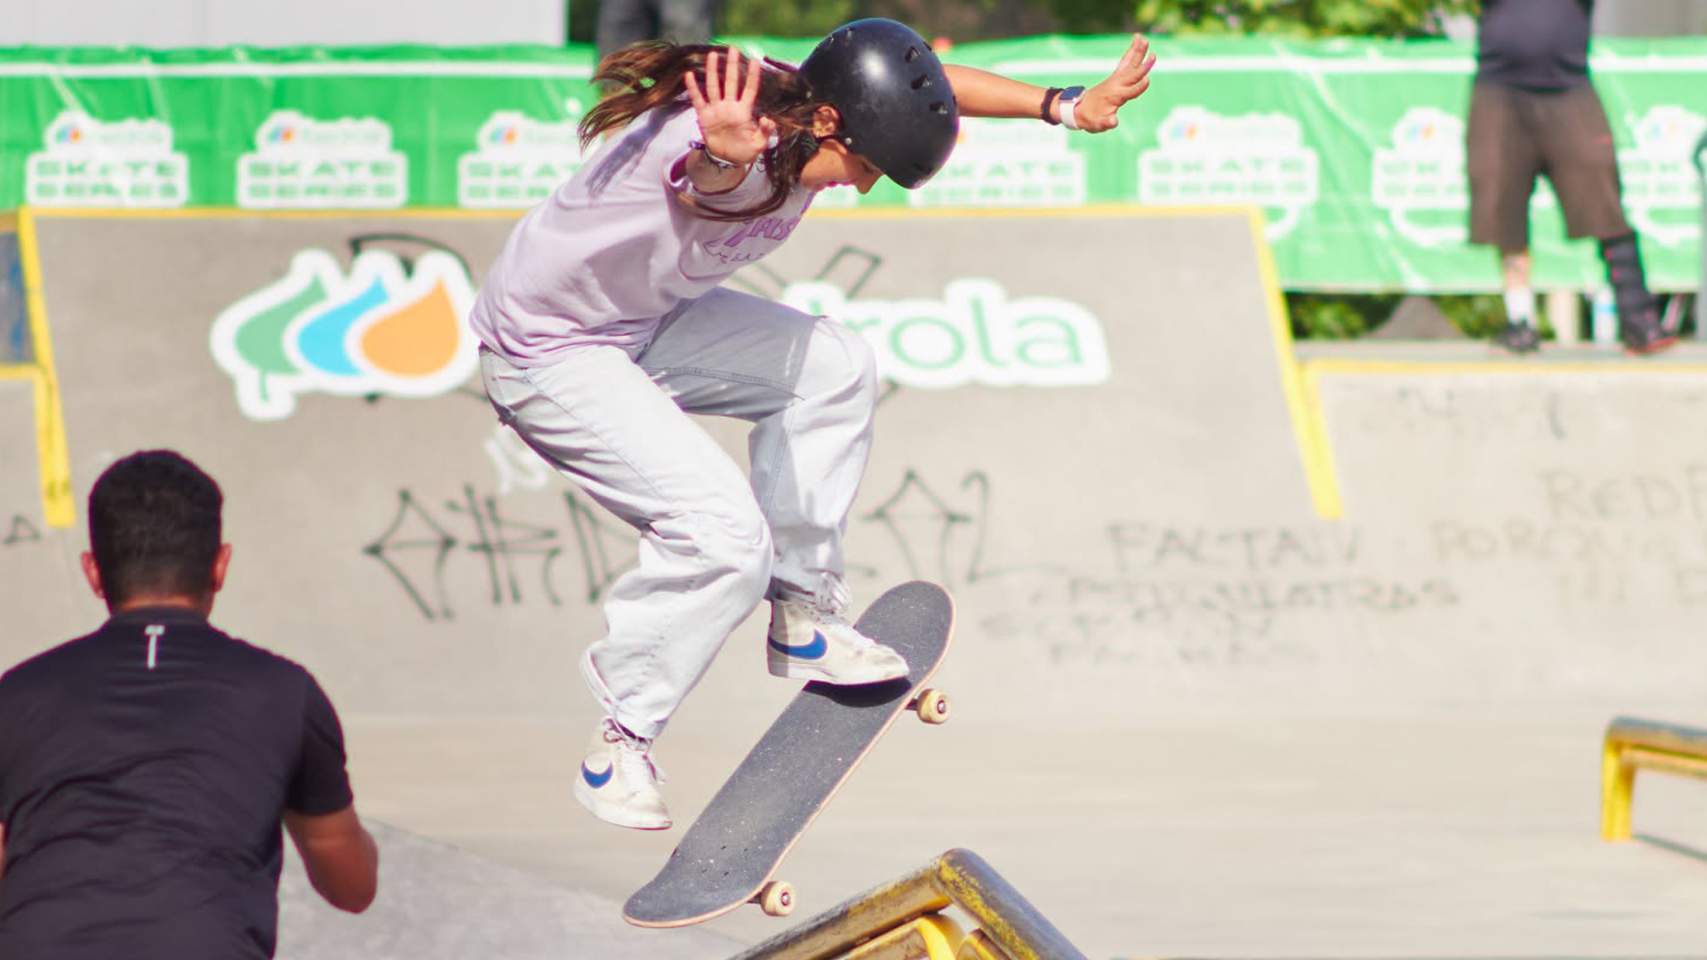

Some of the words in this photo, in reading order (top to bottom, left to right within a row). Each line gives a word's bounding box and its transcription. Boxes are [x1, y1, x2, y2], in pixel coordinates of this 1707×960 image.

[248, 160, 397, 177] SKATE
[938, 160, 1074, 178] KATE
[1149, 157, 1308, 176] SKATE
